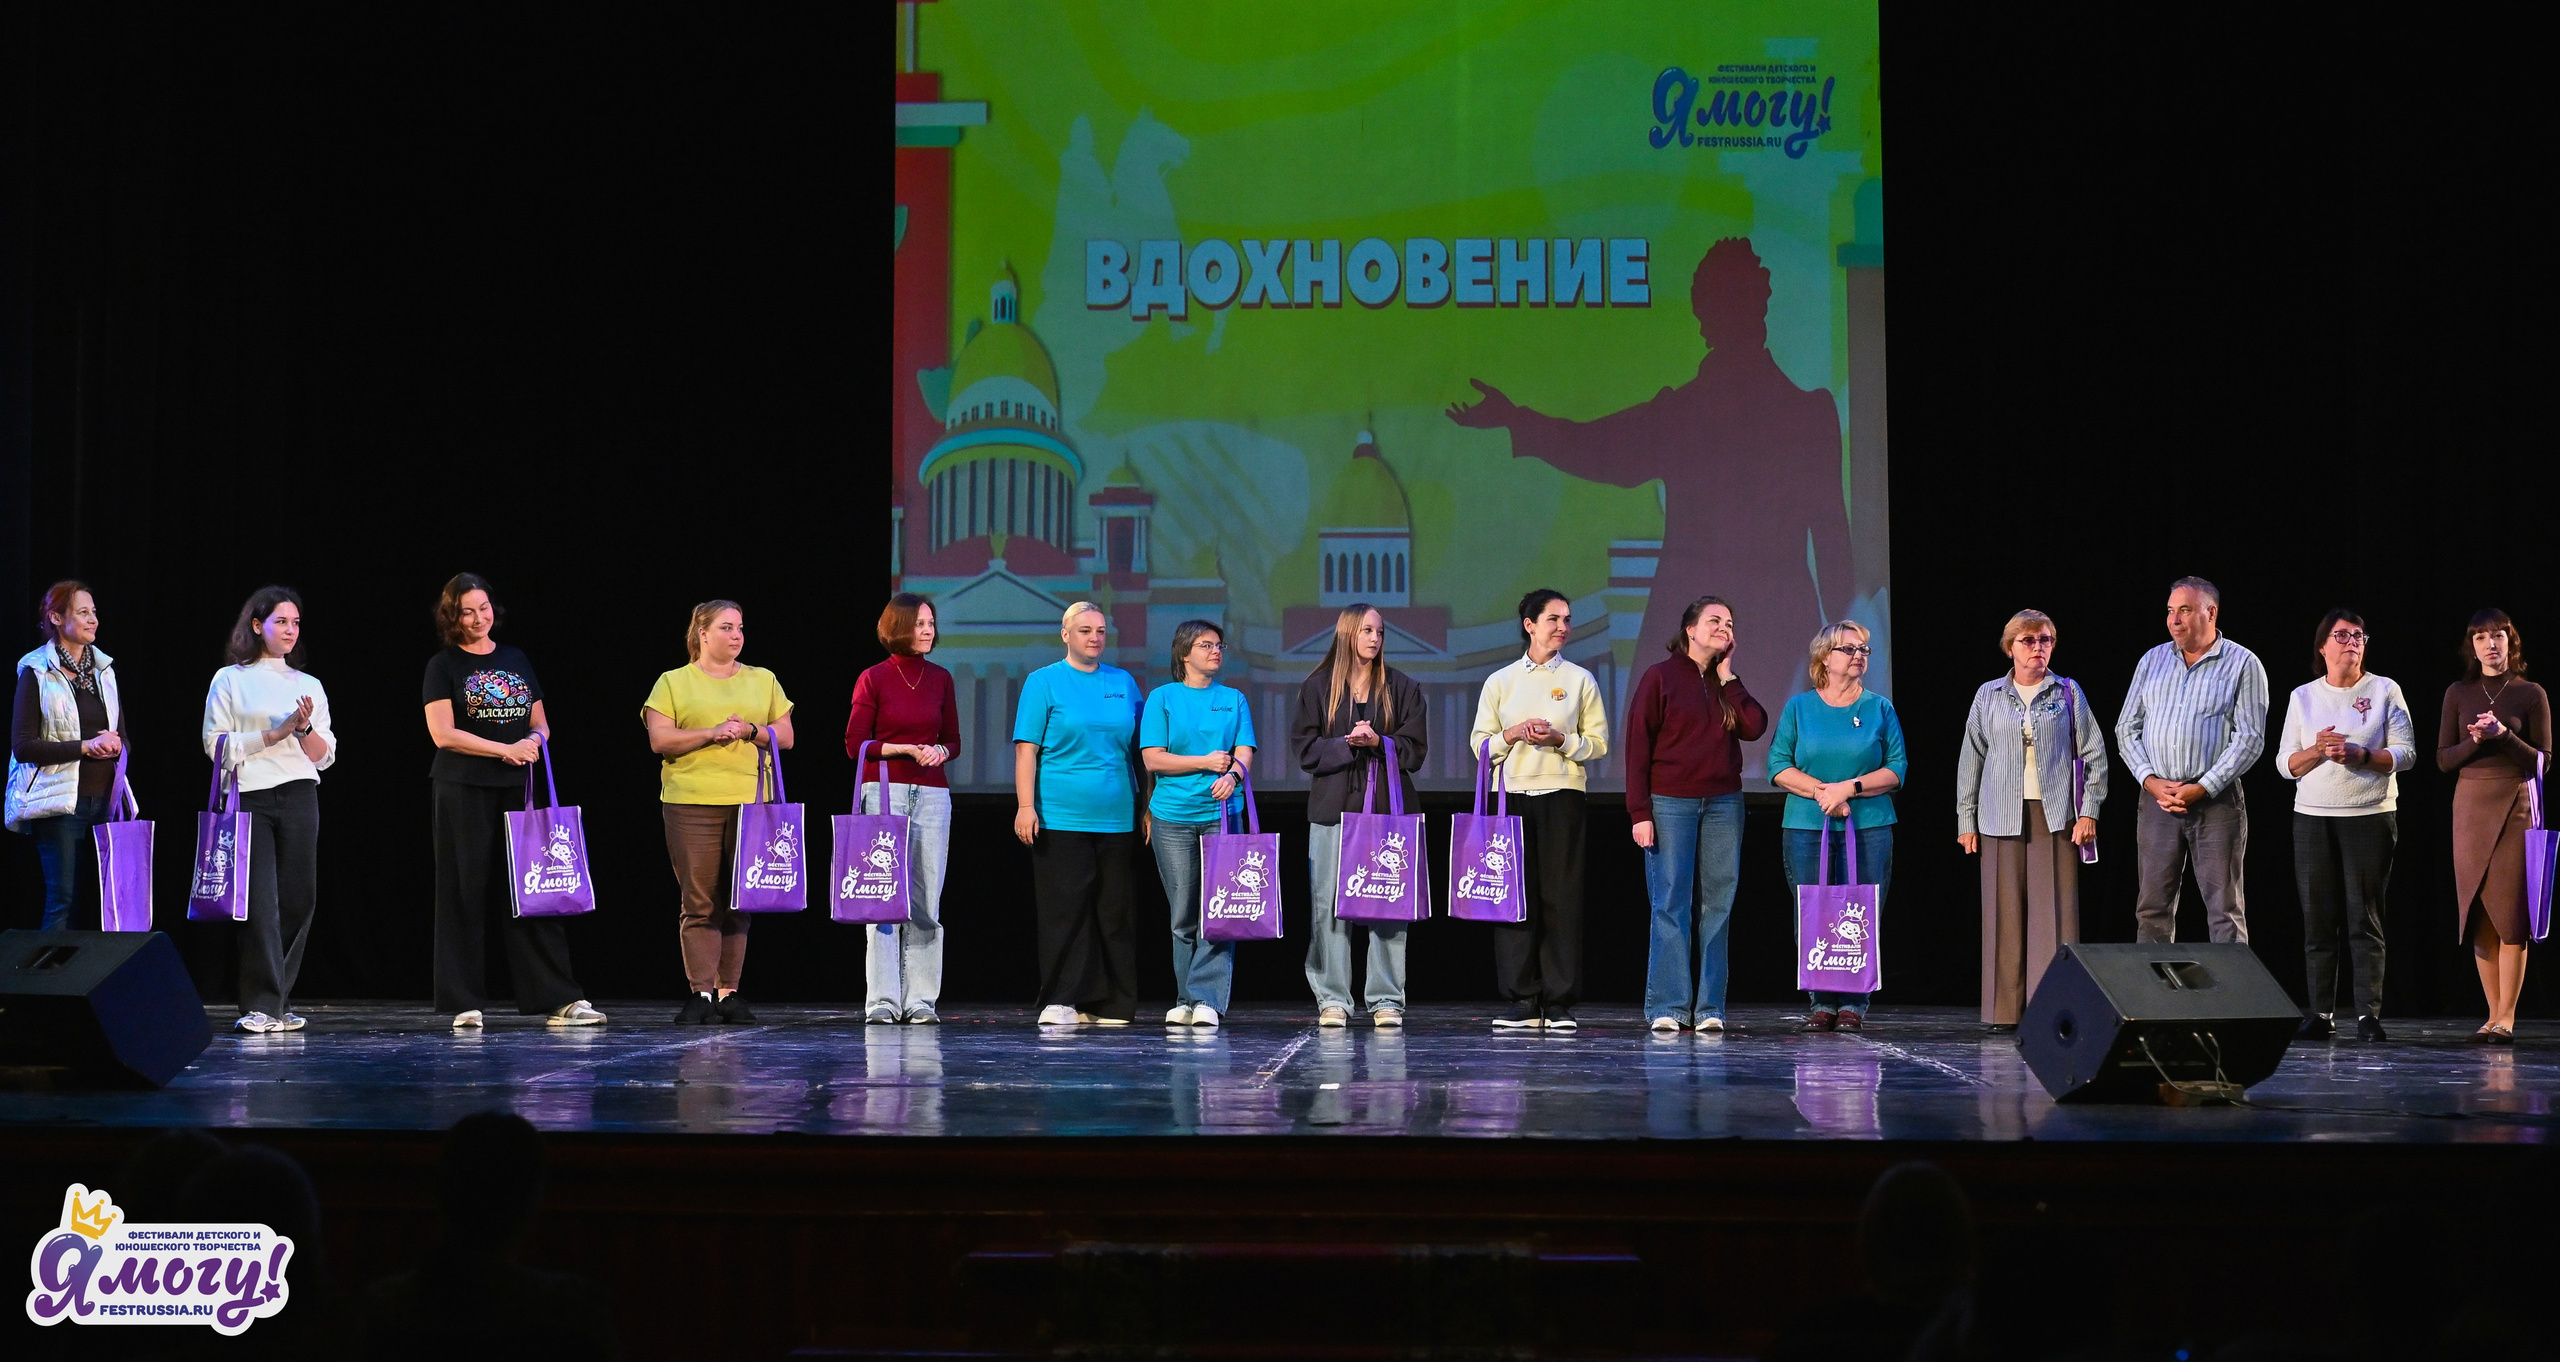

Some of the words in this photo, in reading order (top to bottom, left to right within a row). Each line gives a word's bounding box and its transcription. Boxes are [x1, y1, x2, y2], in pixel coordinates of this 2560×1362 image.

[1708, 76, 1764, 84] ЮНОШЕСКОГО
[1766, 76, 1816, 84] ТВОРЧЕСТВА
[1718, 65, 1765, 73] ФЕСТИВАЛИ
[1767, 65, 1808, 74] ДЕТСКОГО
[1649, 67, 1699, 149] Я
[1697, 77, 1835, 159] могу!
[1697, 136, 1782, 148] FESTRUSSIA.RU
[1085, 237, 1652, 322] ВДОХНОВЕНИЕ
[477, 707, 526, 718] МАСКАРАД
[524, 871, 542, 894] Я
[541, 872, 581, 894] могу!
[746, 866, 762, 888] Я
[760, 872, 797, 892] могу!
[840, 876, 858, 899] Я
[856, 881, 898, 902] могу!
[1345, 874, 1364, 897] Я
[1362, 883, 1406, 902] могу!
[1457, 876, 1474, 898] Я
[1472, 884, 1509, 904] могу!
[1208, 896, 1225, 919] Я
[1224, 901, 1266, 921] могу!
[1807, 948, 1825, 970] Я
[1824, 953, 1868, 974] могу!
